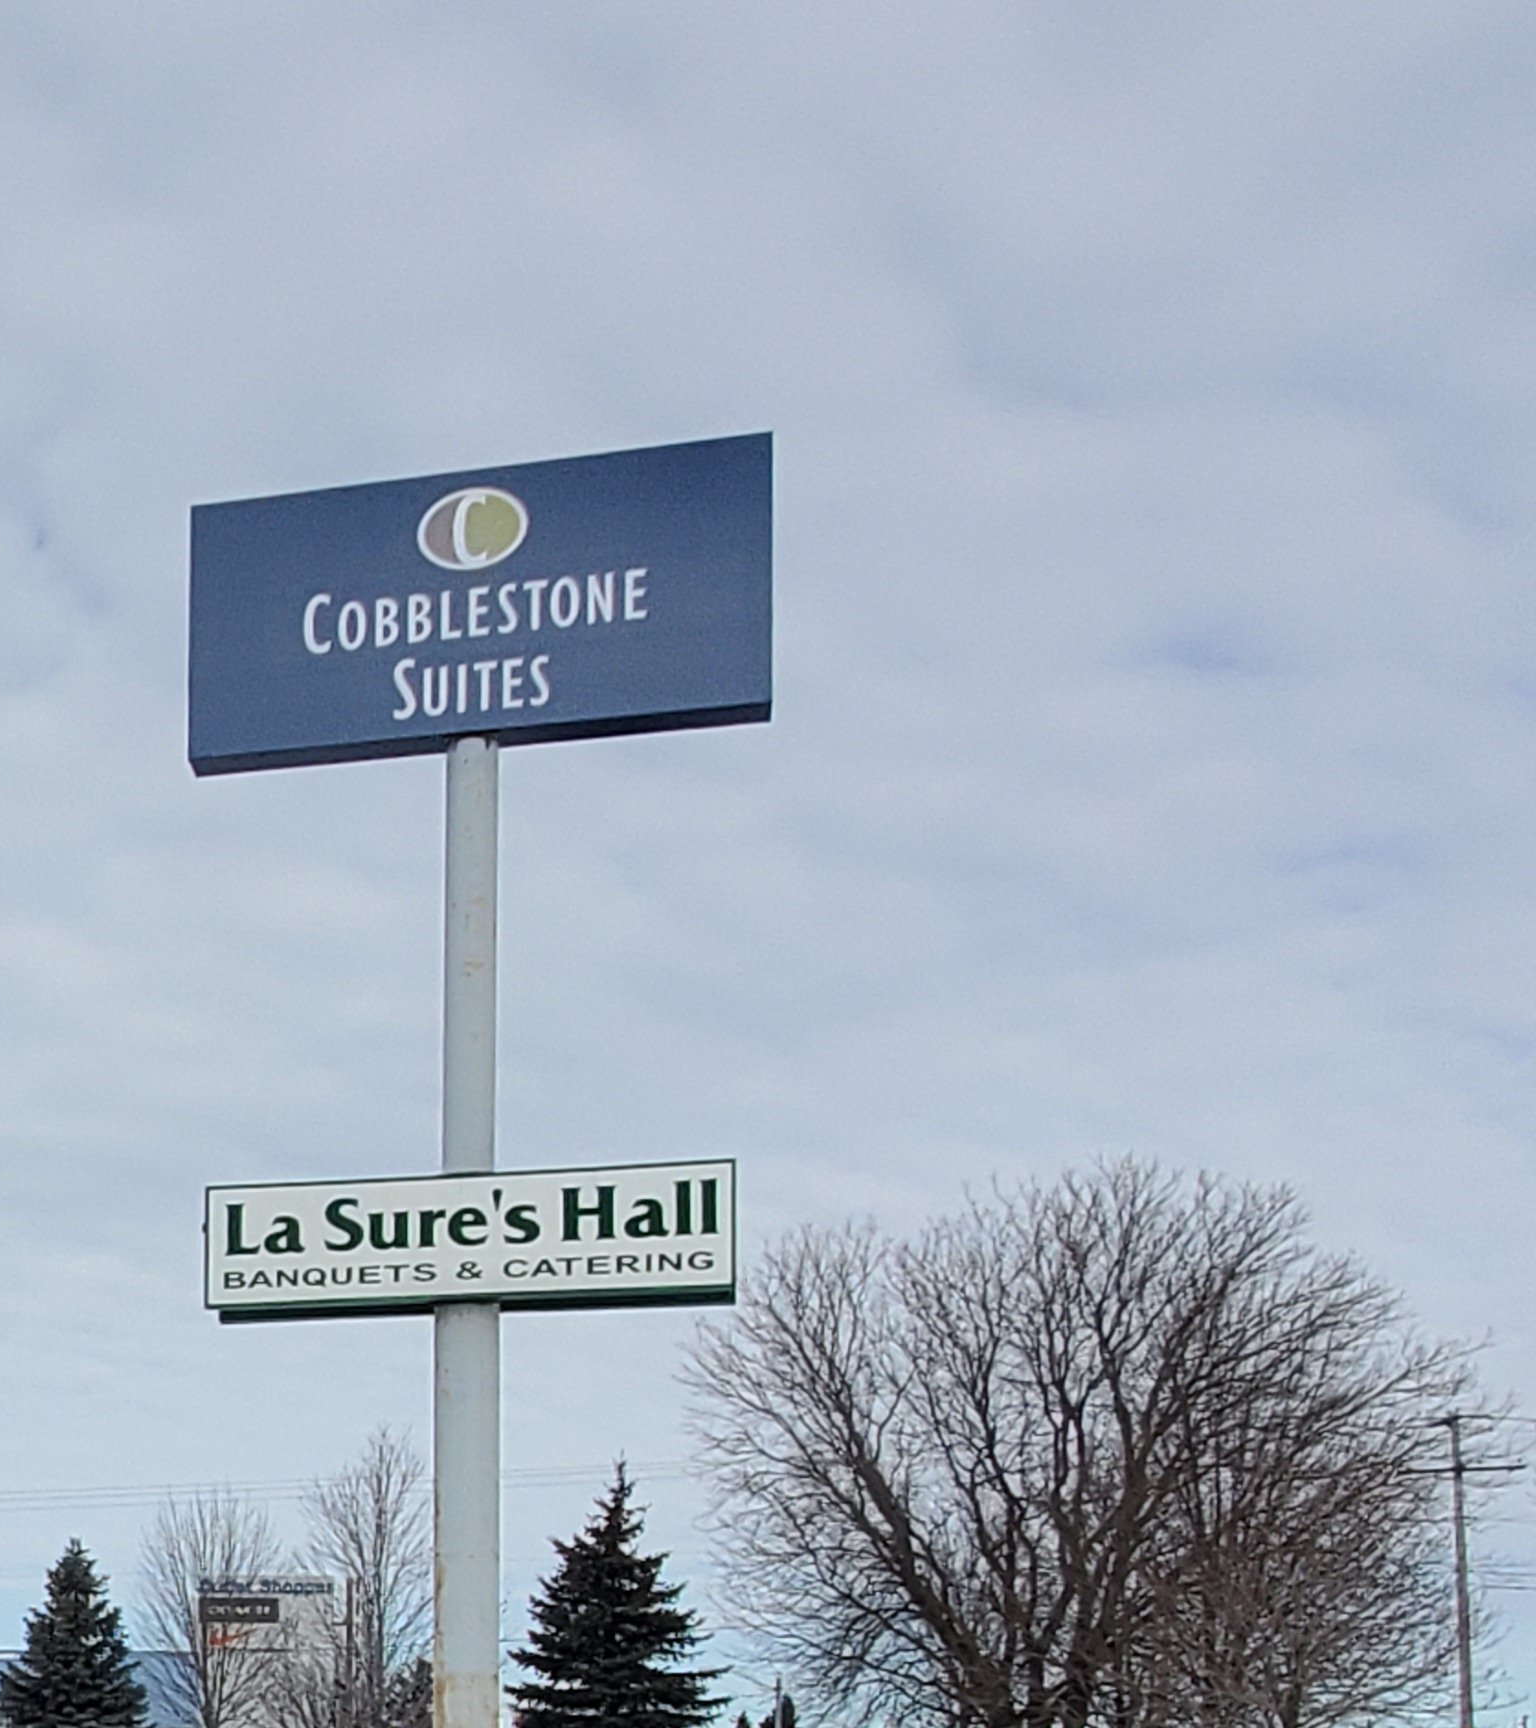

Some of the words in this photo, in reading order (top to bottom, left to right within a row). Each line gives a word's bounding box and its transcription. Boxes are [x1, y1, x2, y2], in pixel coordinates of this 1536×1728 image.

[303, 568, 649, 654] COBBLESTONE
[393, 655, 551, 721] SUITES
[224, 1203, 305, 1257] La
[323, 1187, 542, 1253] Sure's
[561, 1178, 720, 1243] Hall
[223, 1262, 437, 1290] BANQUETS
[456, 1260, 484, 1280] &
[503, 1250, 716, 1279] CATERING
